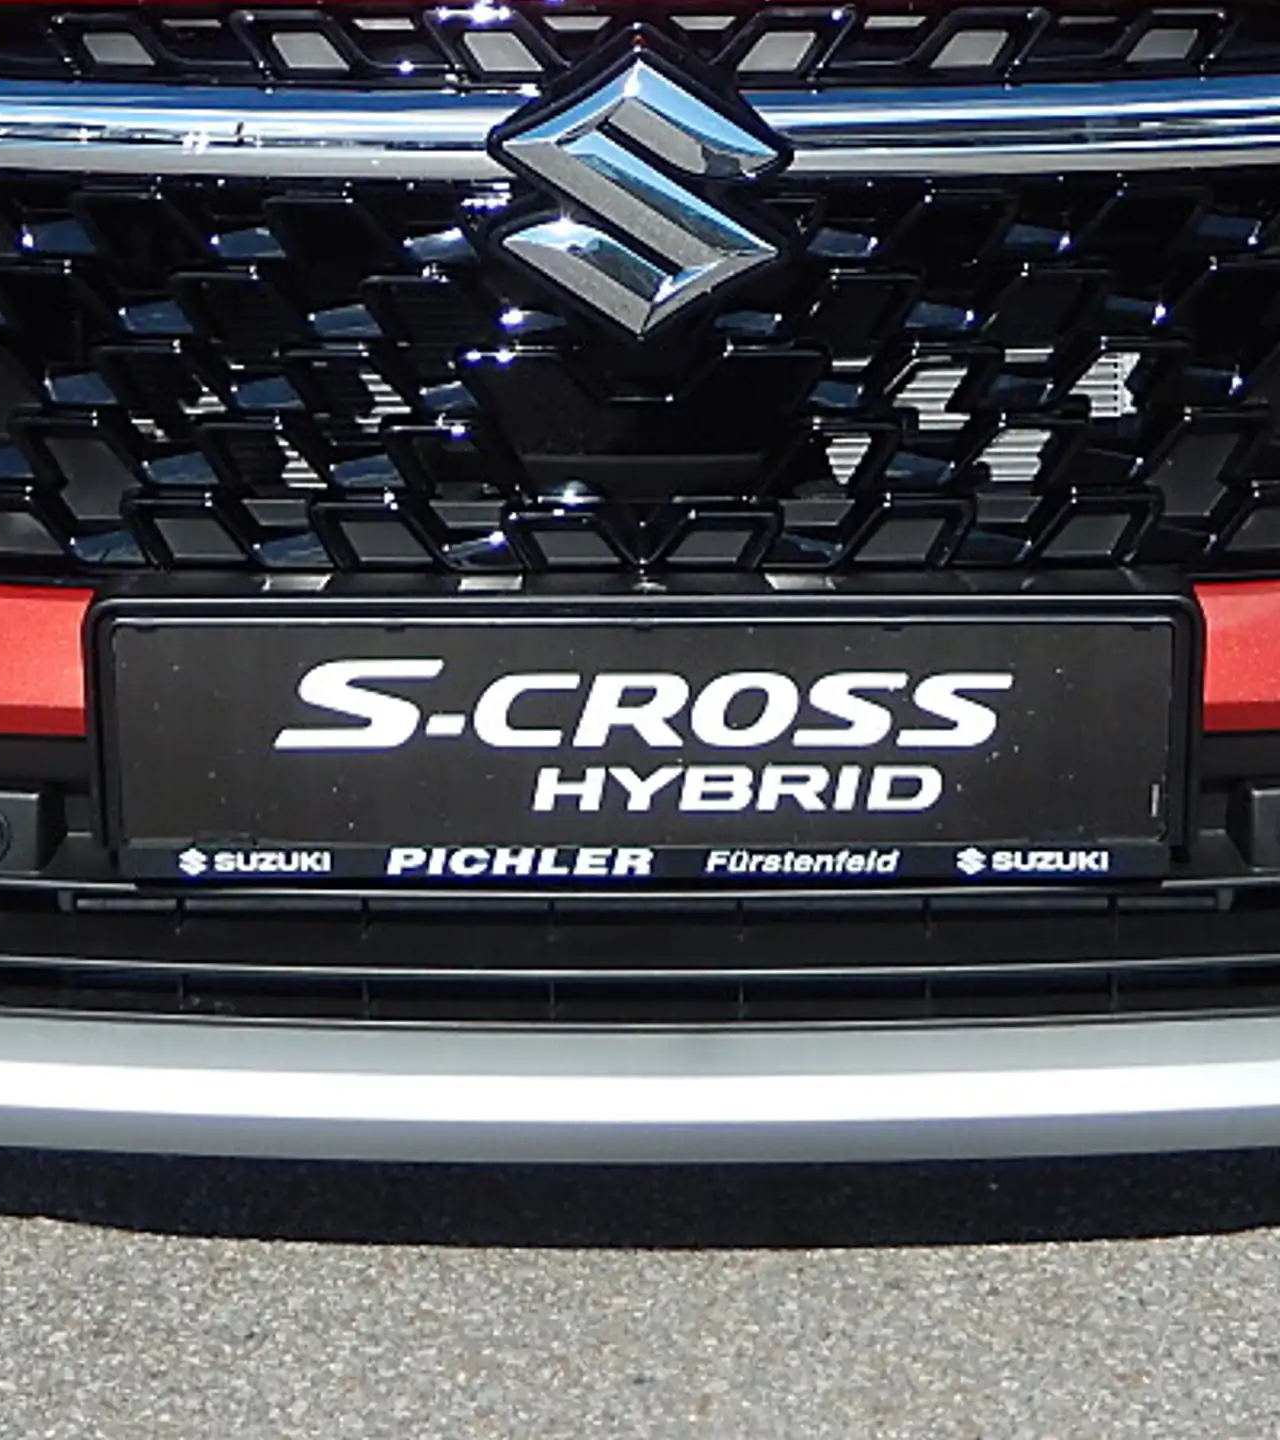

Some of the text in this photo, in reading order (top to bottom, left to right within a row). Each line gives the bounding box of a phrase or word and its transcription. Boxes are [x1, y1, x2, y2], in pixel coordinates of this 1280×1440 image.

[274, 658, 1013, 751] S-CROSS
[532, 764, 944, 812] HYBRID
[214, 846, 1109, 876] SUZUKI PICHLER Fürstenfeld SUZUKI
